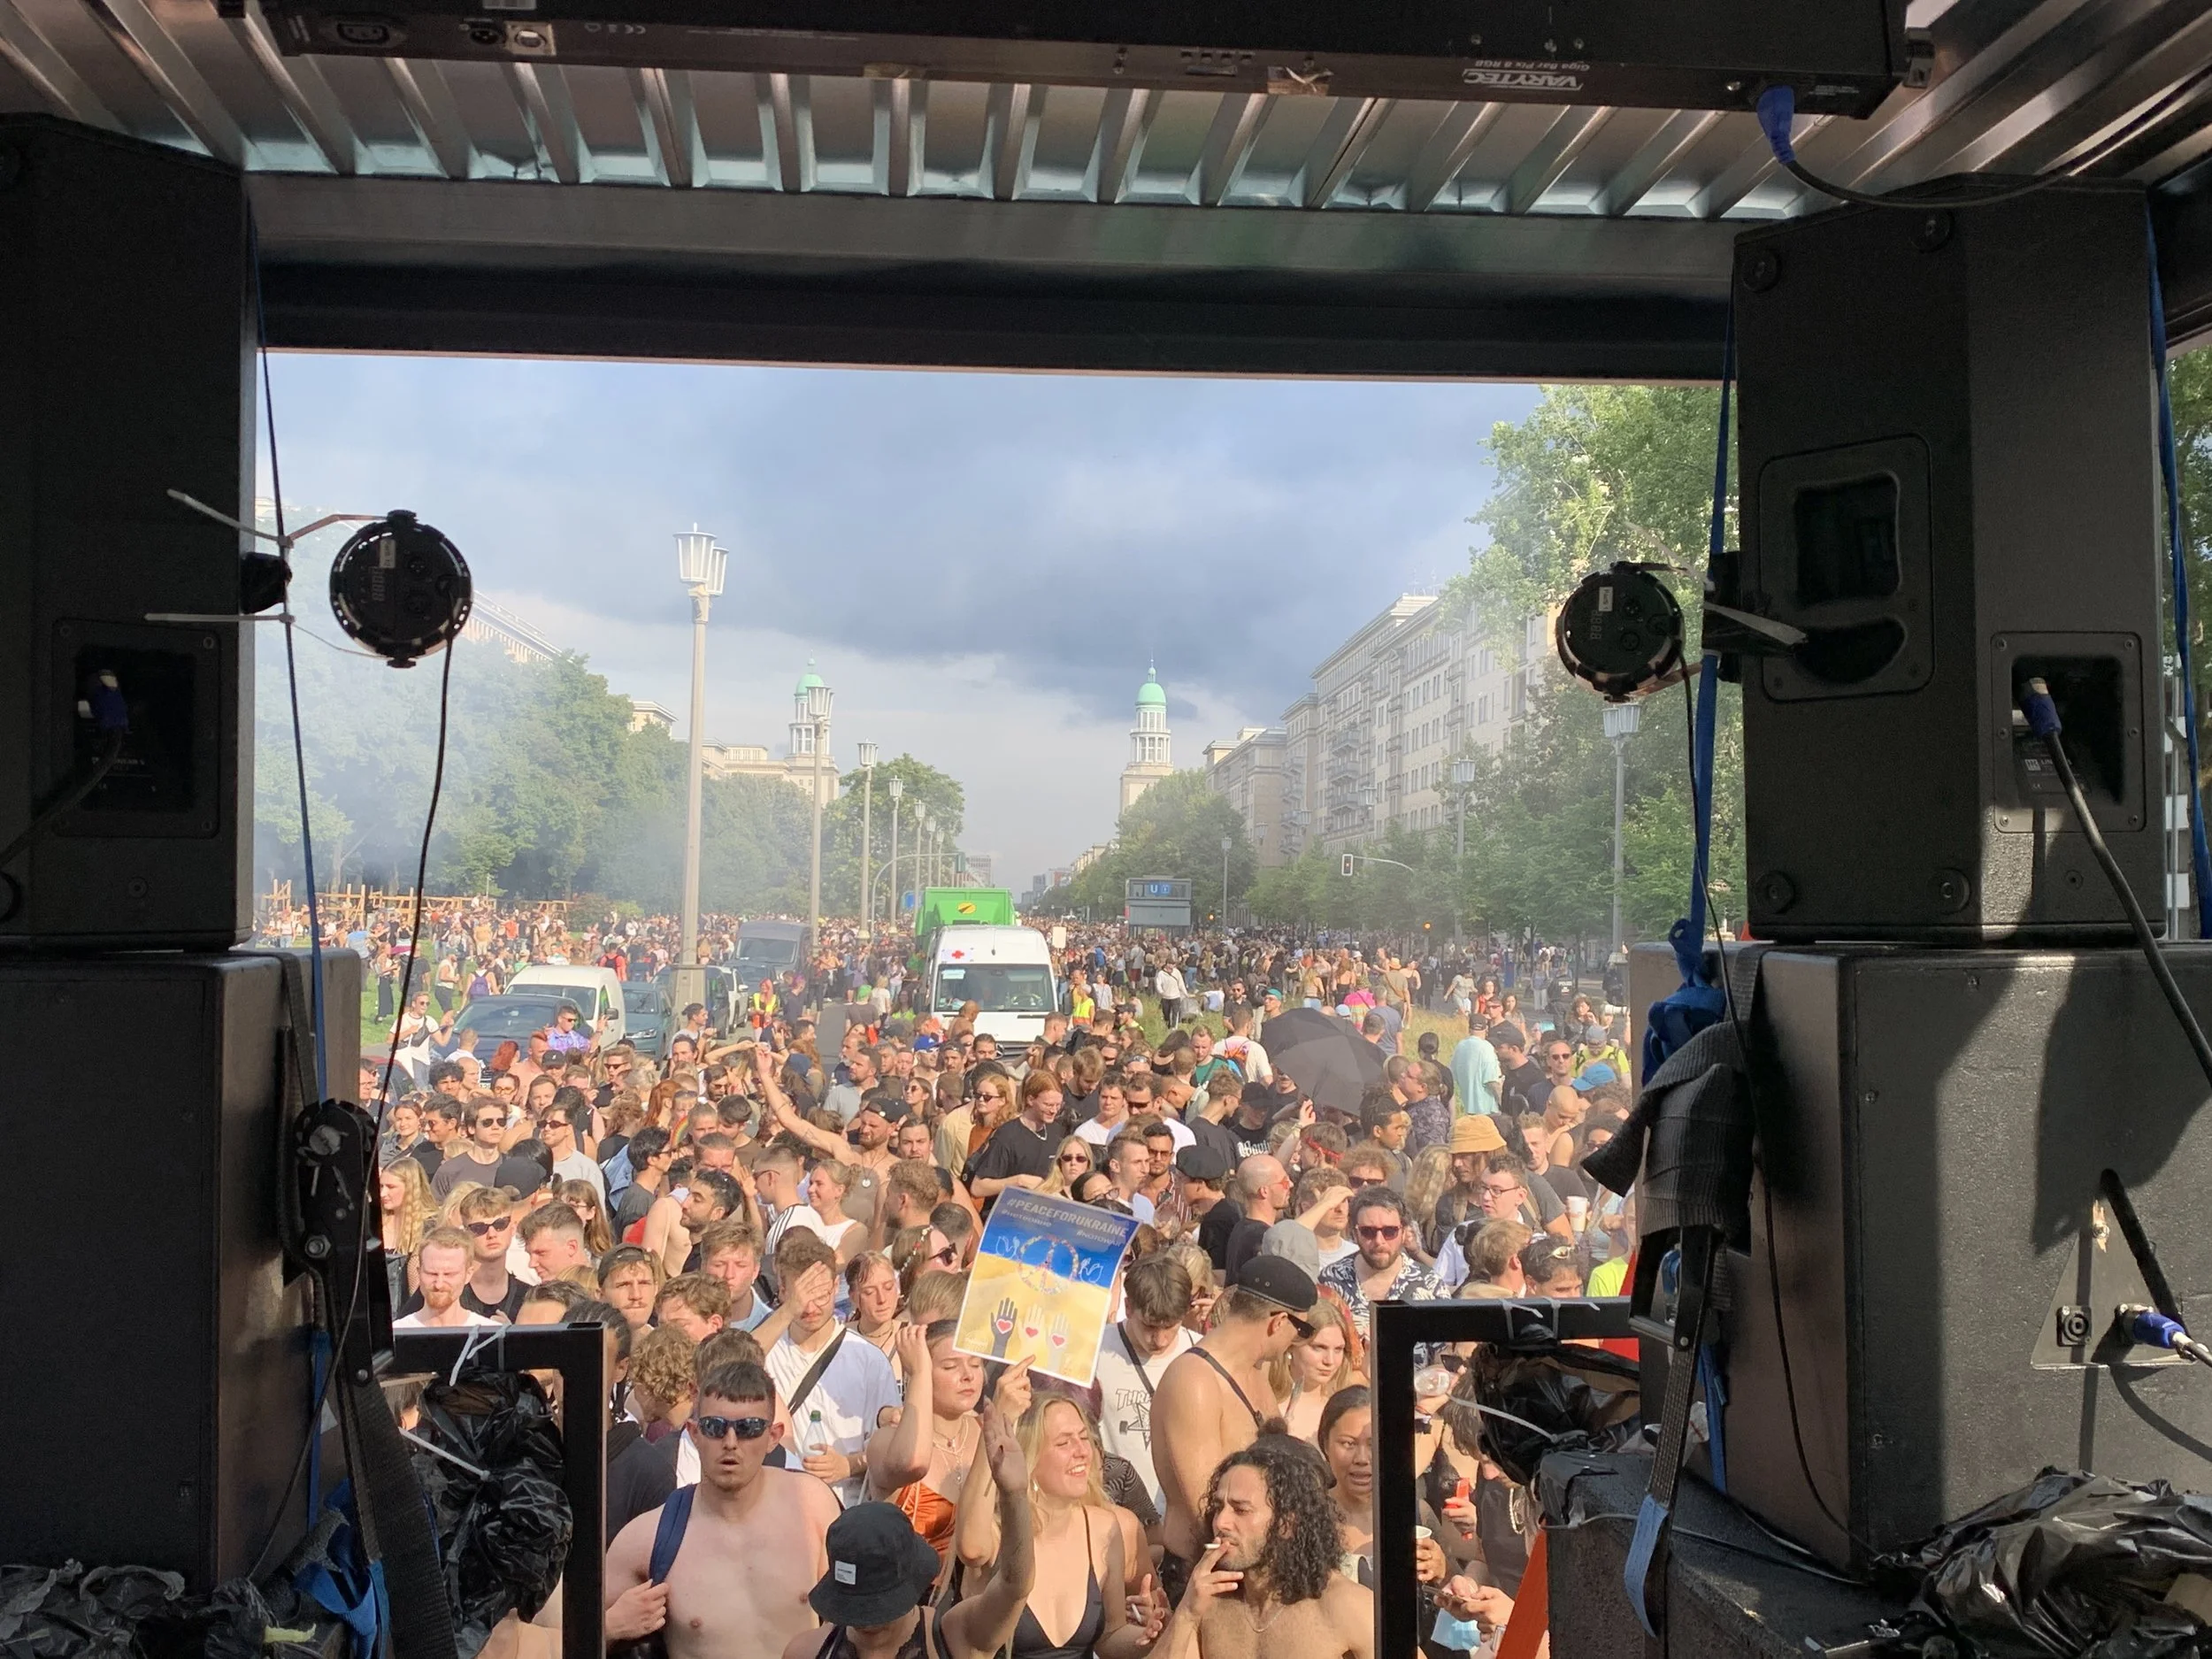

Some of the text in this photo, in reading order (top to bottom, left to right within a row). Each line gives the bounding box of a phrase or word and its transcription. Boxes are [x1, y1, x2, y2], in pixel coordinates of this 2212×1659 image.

[1474, 59, 1502, 68] RGB
[1561, 61, 1590, 72] Giga
[1463, 71, 1578, 88] VARYTEC
[1149, 884, 1158, 894] U
[1007, 1198, 1130, 1238] #PEACEFORUKRAINE
